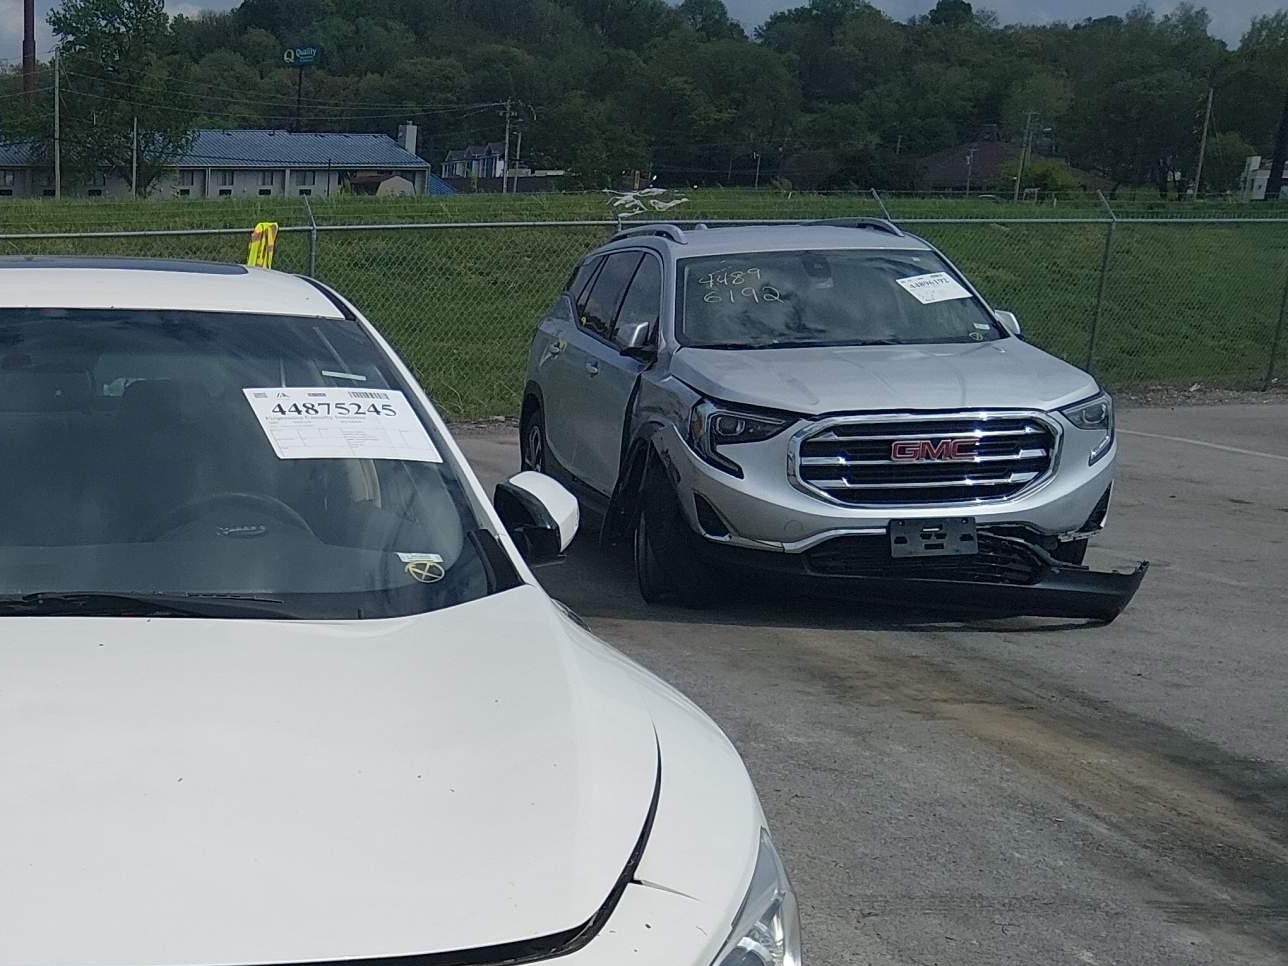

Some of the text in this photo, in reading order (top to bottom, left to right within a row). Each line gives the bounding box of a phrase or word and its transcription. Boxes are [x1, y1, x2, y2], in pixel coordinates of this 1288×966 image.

[296, 47, 317, 58] Quality
[698, 267, 761, 289] 4489
[703, 286, 784, 304] 6192
[272, 402, 397, 417] 44875245
[891, 438, 980, 462] GMC
